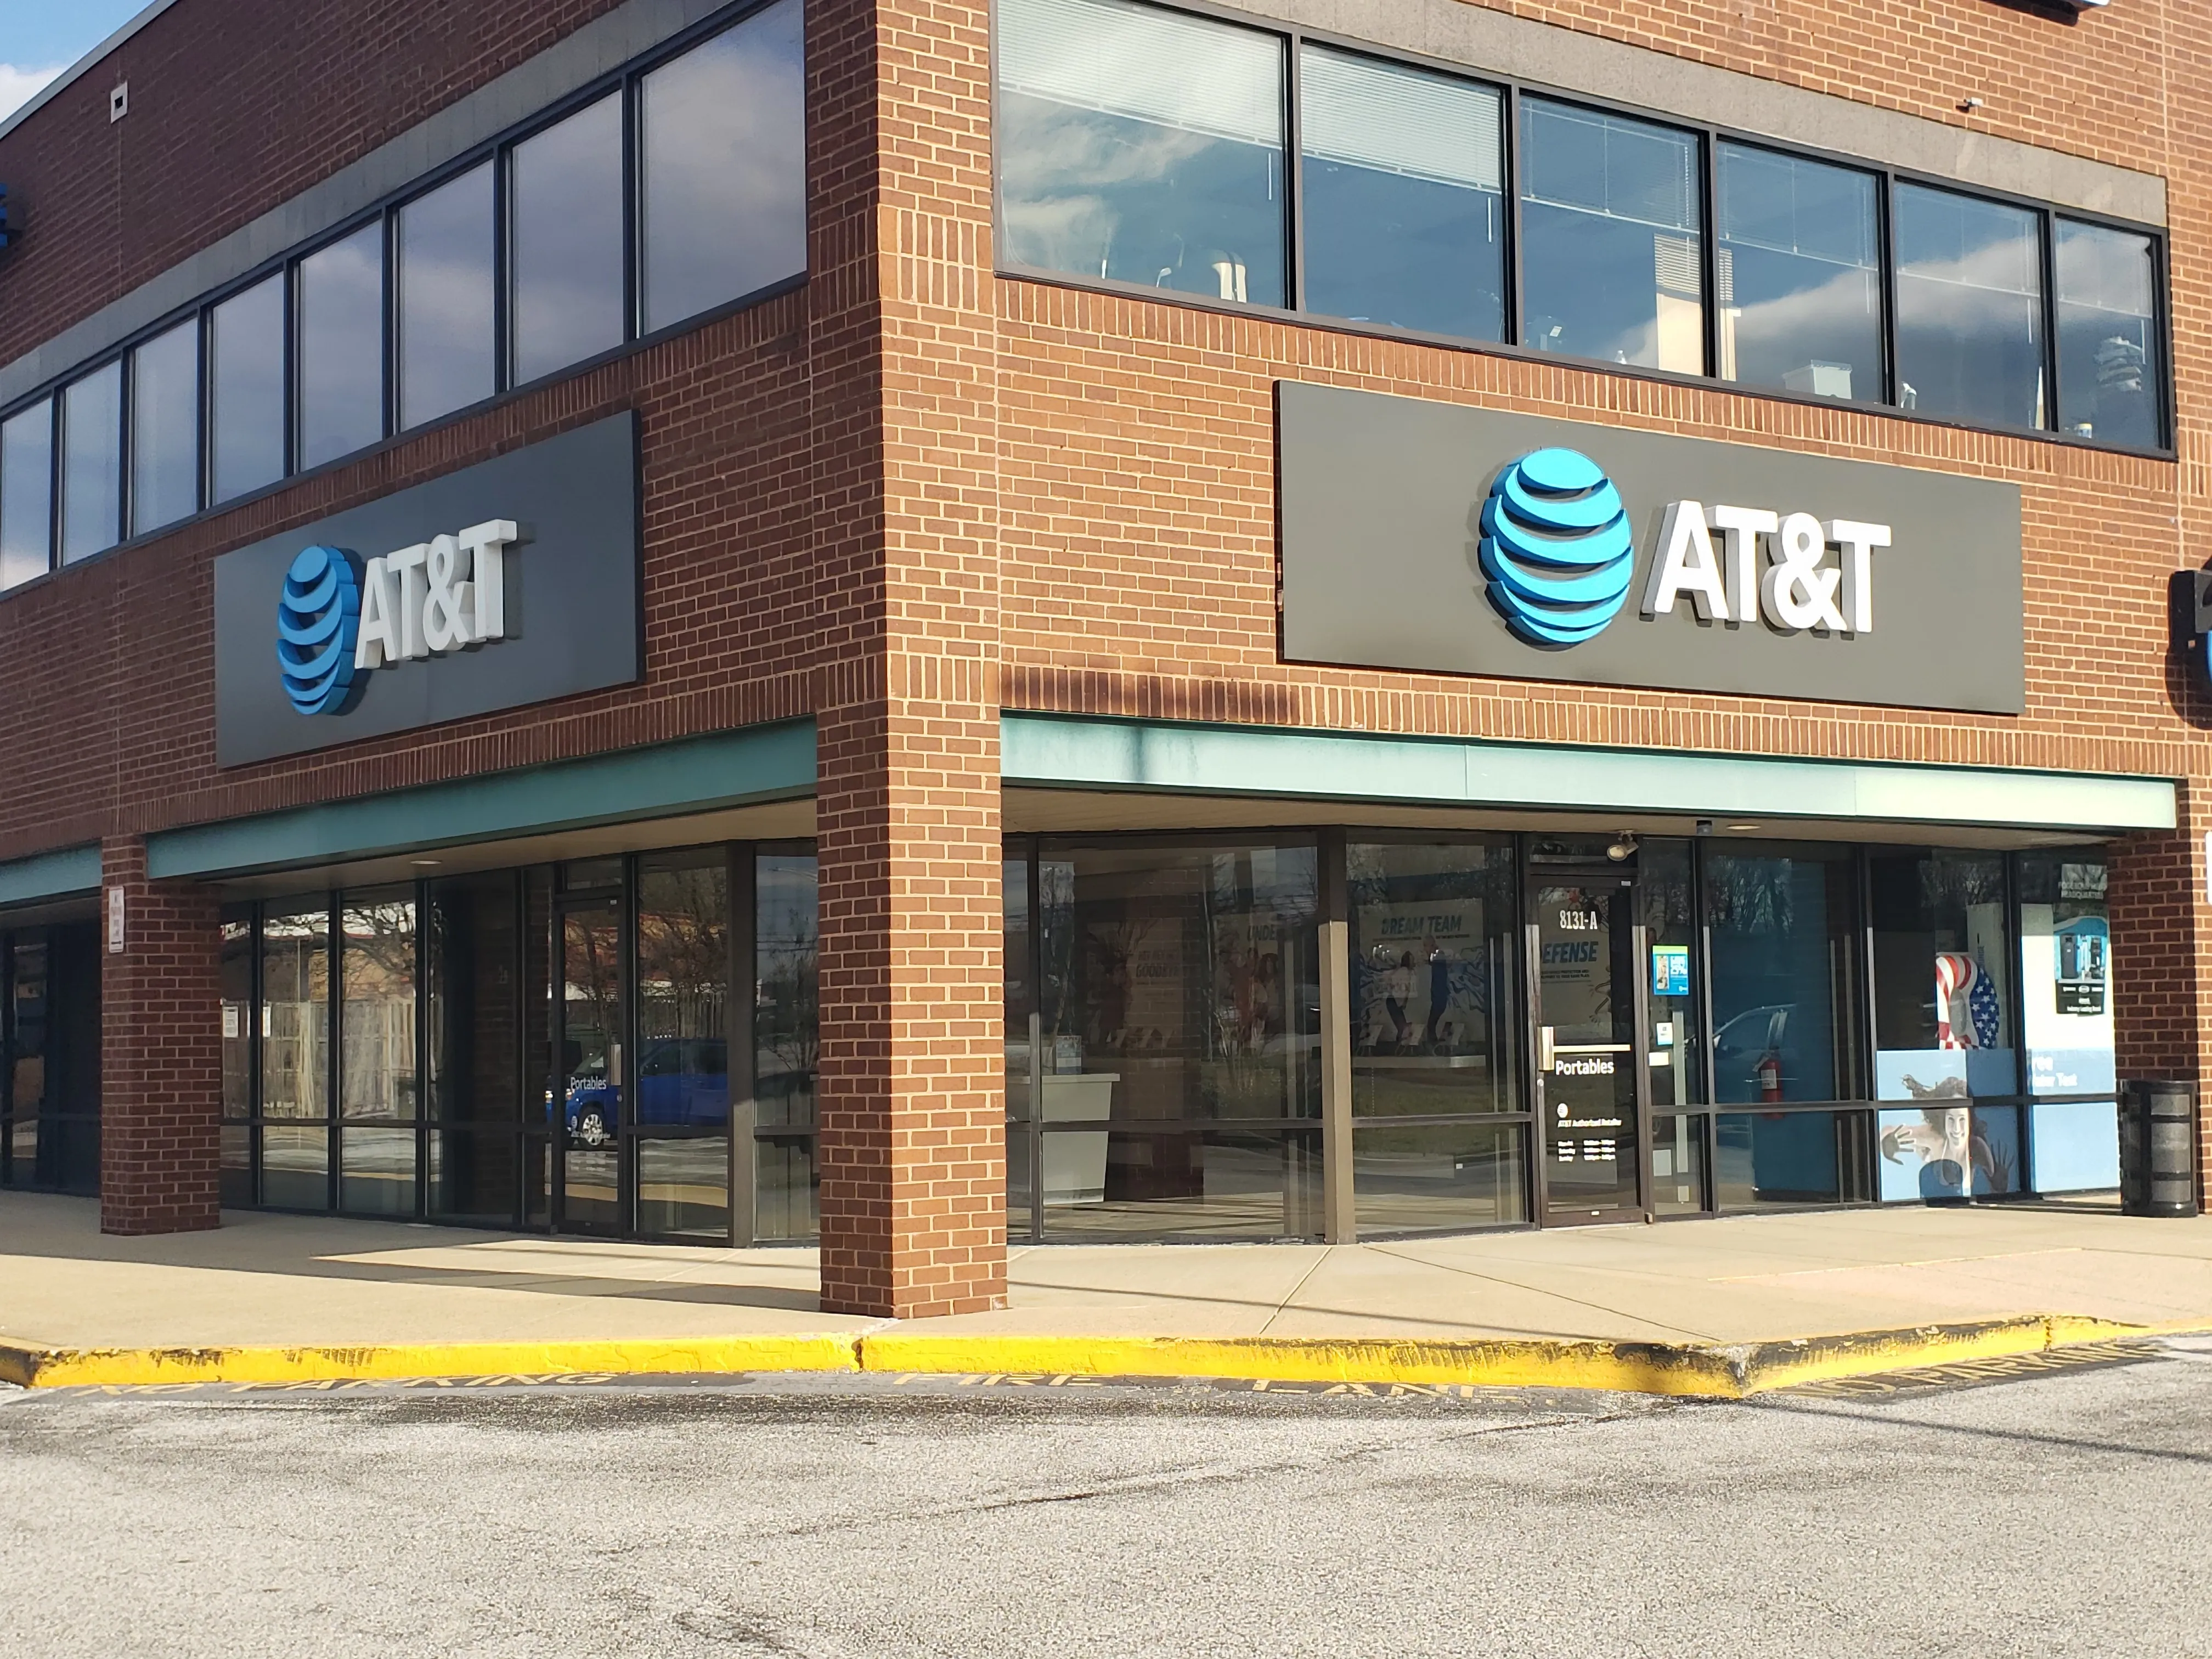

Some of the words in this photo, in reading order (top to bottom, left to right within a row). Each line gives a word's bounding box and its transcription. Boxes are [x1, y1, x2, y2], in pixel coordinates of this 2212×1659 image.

[1640, 500, 1891, 634] AT&T
[354, 519, 517, 669] AT&T
[1381, 917, 1424, 935] DREAM
[1427, 915, 1462, 933] TEAM
[1560, 910, 1598, 929] 8131-A
[1555, 1058, 1615, 1075] Portables
[571, 1076, 607, 1090] Portables
[71, 1383, 205, 1397] NO
[229, 1373, 619, 1393] PARKING
[893, 1373, 1115, 1386] FIRE
[1252, 1380, 1522, 1399] LANE
